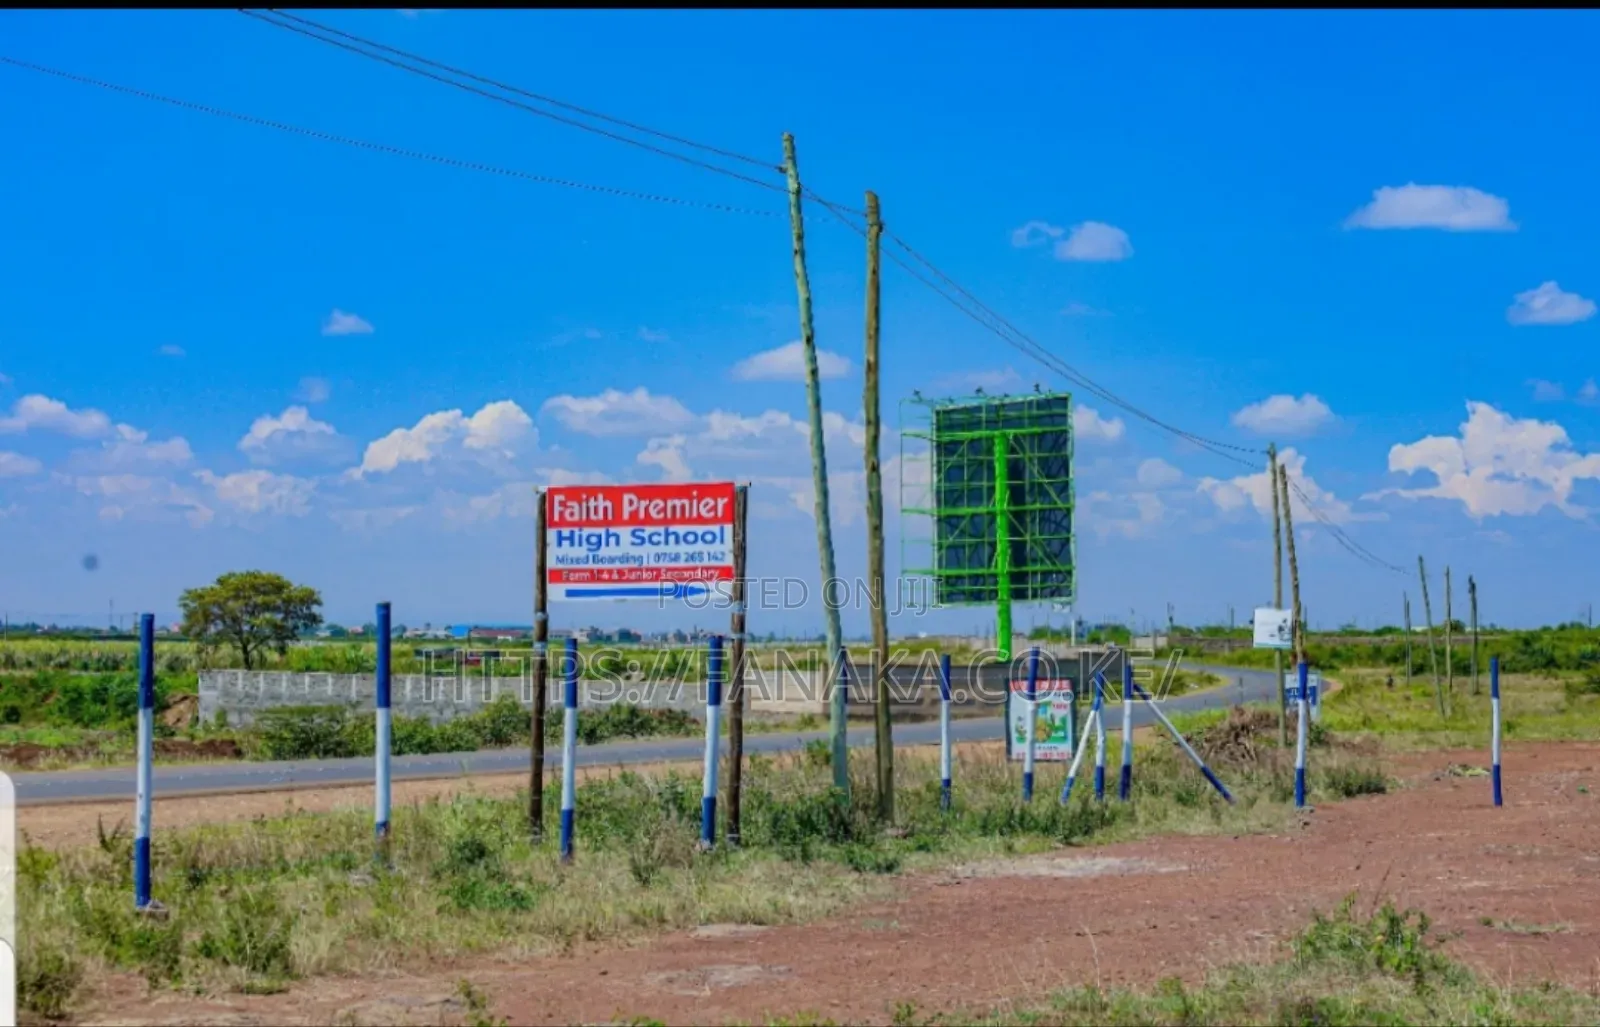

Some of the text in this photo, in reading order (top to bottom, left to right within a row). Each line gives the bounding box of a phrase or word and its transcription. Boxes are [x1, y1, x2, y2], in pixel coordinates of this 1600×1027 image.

[552, 490, 728, 522] Faith Premier
[556, 526, 725, 552] High School
[555, 554, 590, 566] Mixed
[592, 553, 644, 567] Boarding
[562, 570, 590, 581] Form
[622, 568, 657, 580] Junior
[660, 567, 720, 580] Secondary
